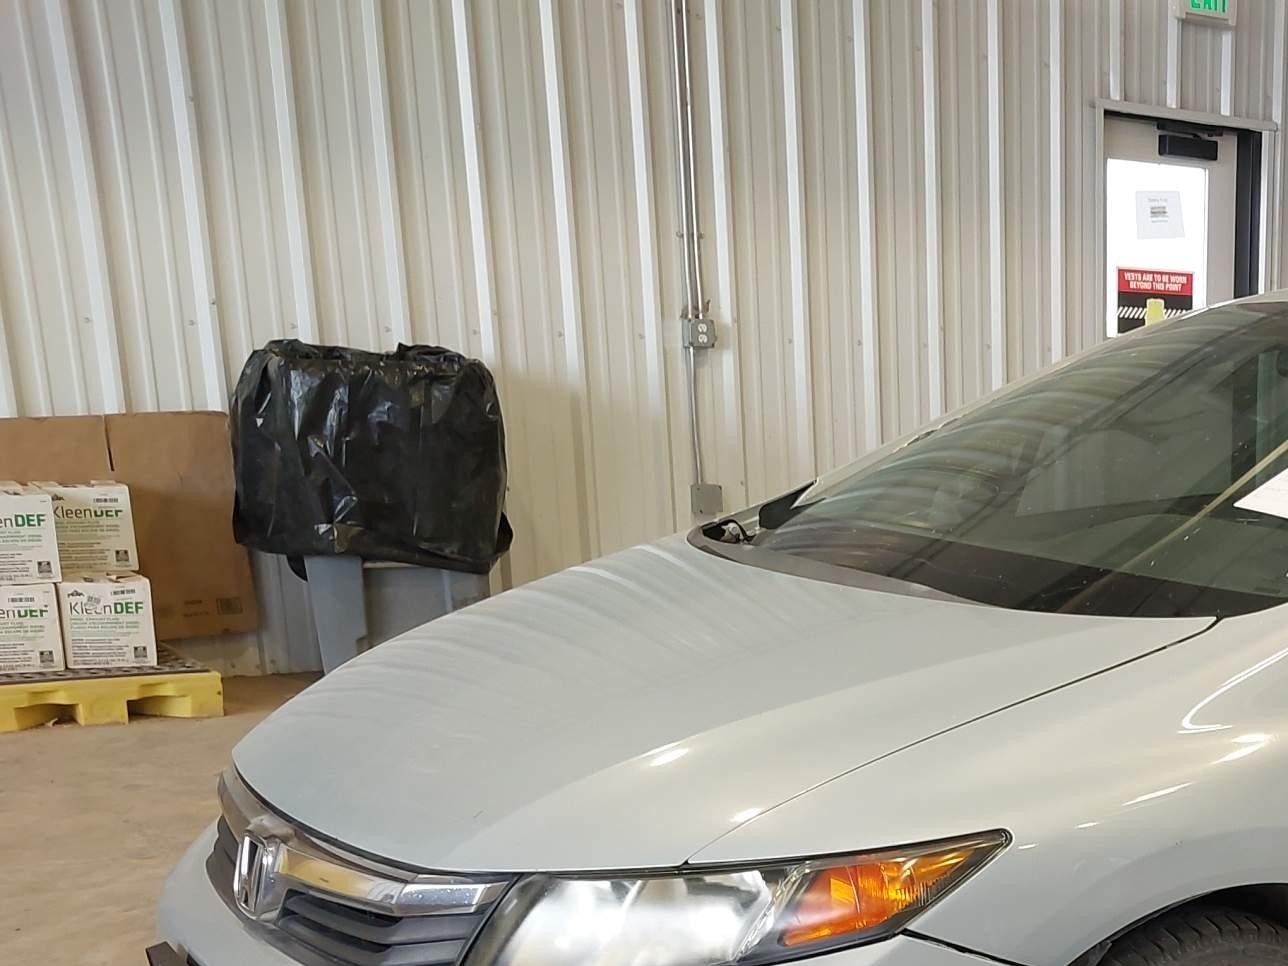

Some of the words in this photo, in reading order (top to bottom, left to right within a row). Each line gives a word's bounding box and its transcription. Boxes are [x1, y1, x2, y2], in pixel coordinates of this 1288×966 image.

[1154, 274, 1161, 282] TO
[1170, 275, 1187, 284] WORN
[1130, 281, 1152, 290] BEYOND
[1153, 282, 1164, 291] THIS
[1166, 283, 1182, 292] POINT
[0, 514, 46, 528] nDEF
